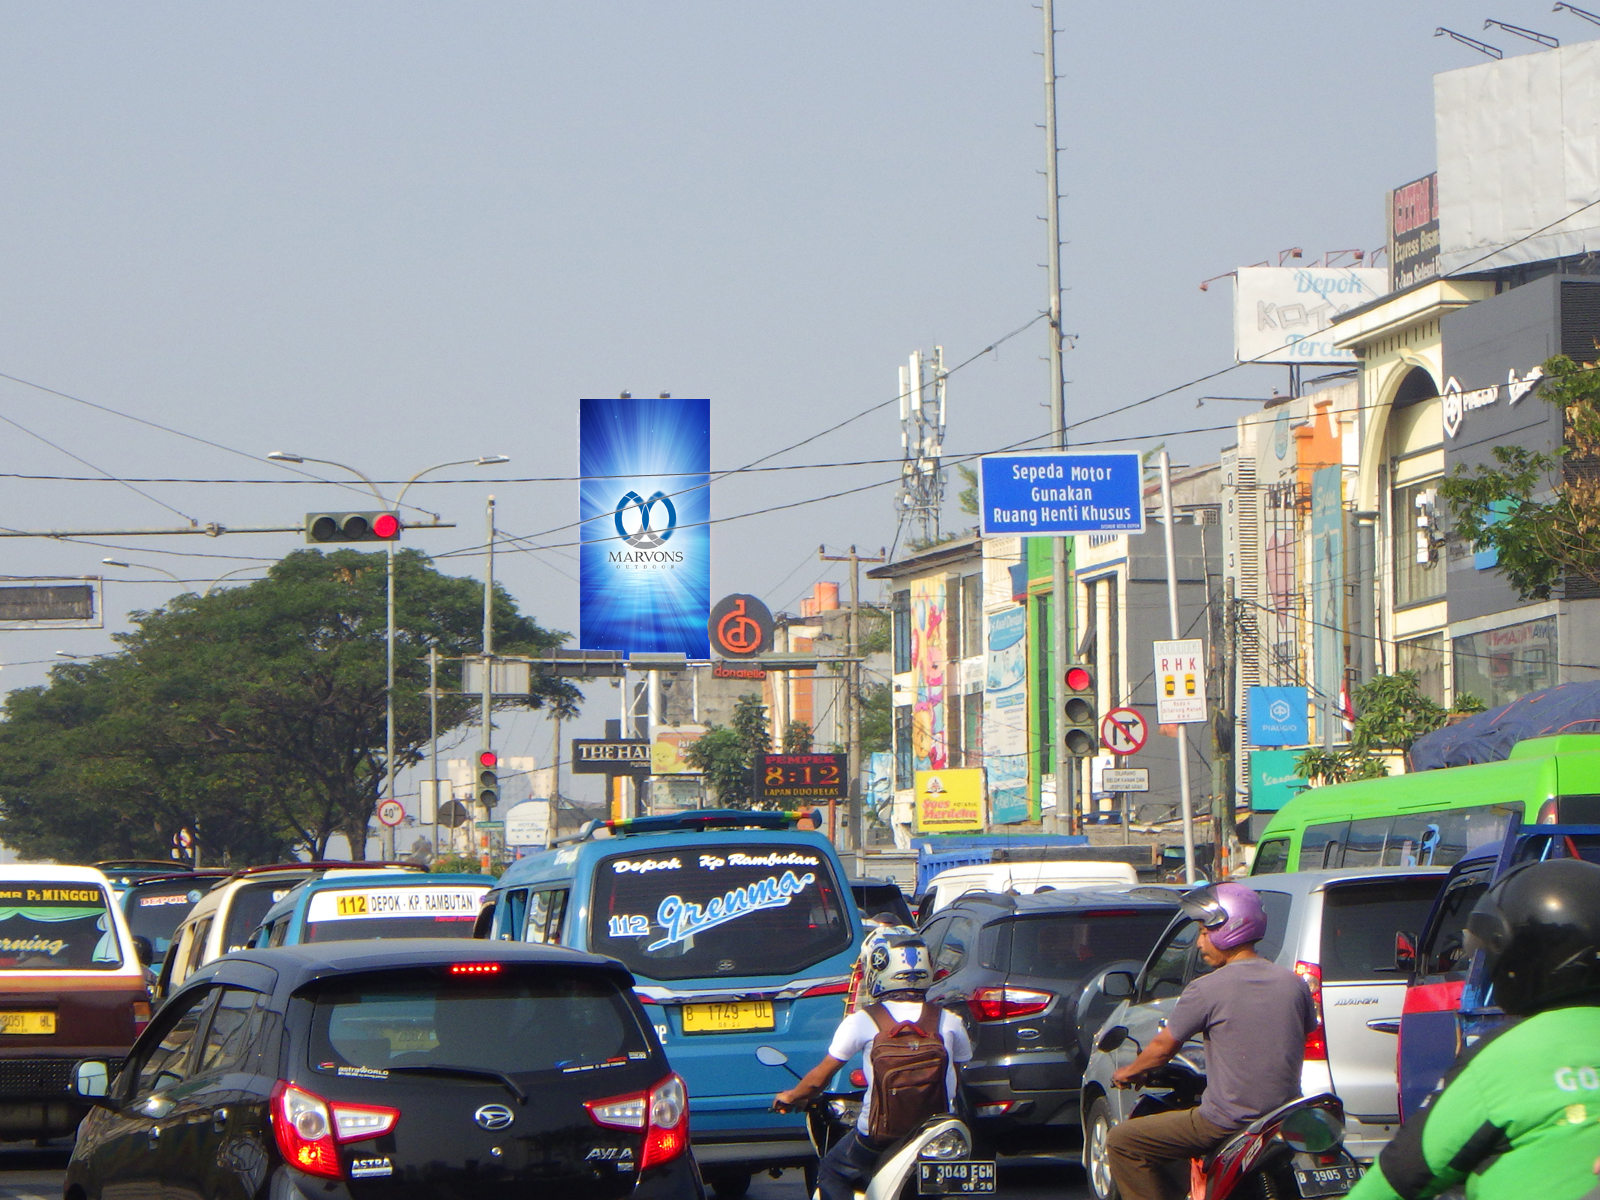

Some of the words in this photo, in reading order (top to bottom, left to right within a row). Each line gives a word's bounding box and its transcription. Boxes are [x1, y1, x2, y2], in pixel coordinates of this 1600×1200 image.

[1294, 271, 1363, 299] Depok
[1257, 300, 1349, 332] KOT
[1012, 463, 1063, 483] Sepeda
[1071, 466, 1112, 482] Motor
[1031, 486, 1092, 502] Gunakan
[993, 507, 1037, 526] Ruang
[1041, 505, 1078, 521] Henti
[1081, 505, 1131, 520] Khusus
[608, 551, 684, 562] MARVONS
[714, 665, 766, 679] donatello
[578, 745, 617, 759] THE
[765, 756, 836, 764] PEMPEK
[764, 765, 840, 786] 8:12
[764, 788, 792, 796] LAPAN
[384, 809, 393, 818] 40
[612, 858, 682, 873] Depok
[699, 855, 724, 870] Kp
[727, 853, 819, 867] Rambutan
[26, 889, 41, 901] Ps
[42, 889, 99, 901] MINGGU
[140, 895, 187, 906] DEPOK
[340, 896, 366, 914] 112
[371, 896, 400, 912] DEPOK
[408, 895, 422, 911] KP.
[425, 894, 473, 910] RAMBUTAN
[608, 915, 649, 937] 112
[685, 1006, 694, 1021] B
[708, 1004, 739, 1020] 1749
[754, 1003, 770, 1018] UL
[585, 1147, 634, 1160] AYLA
[352, 1158, 391, 1169] ASTRA
[922, 1165, 930, 1179] B
[937, 1165, 967, 1178] 3048
[1299, 1173, 1307, 1184] B
[1313, 1169, 1341, 1182] 3905
